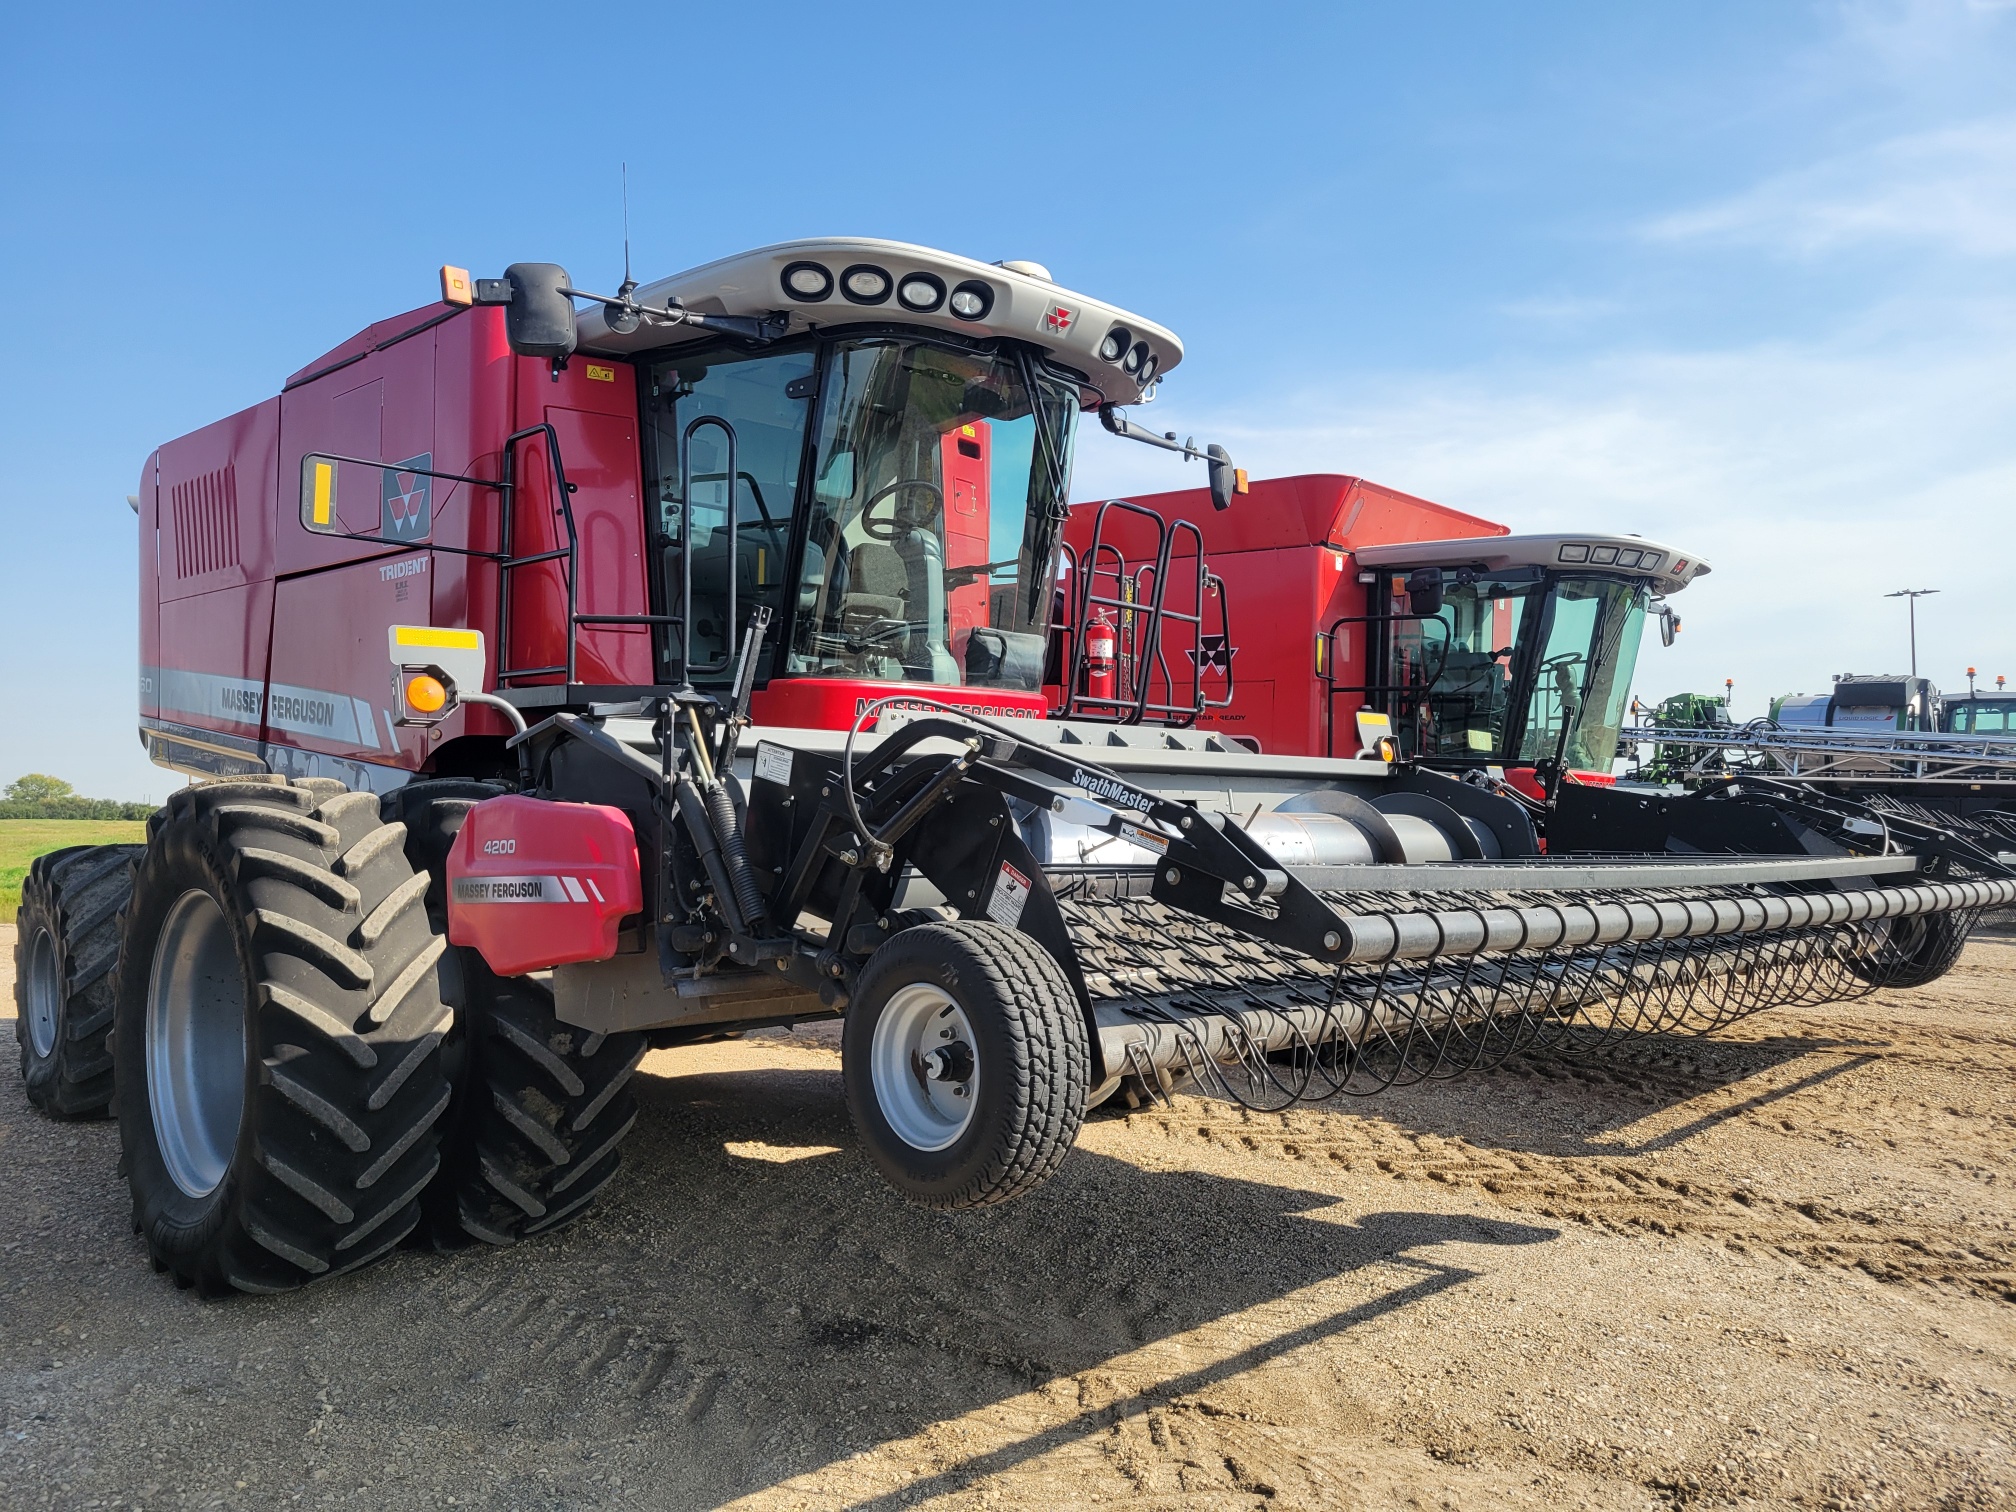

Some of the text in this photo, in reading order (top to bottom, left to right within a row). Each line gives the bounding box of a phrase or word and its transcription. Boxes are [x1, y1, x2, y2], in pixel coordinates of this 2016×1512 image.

[379, 556, 429, 581] TRIDENT
[221, 687, 334, 727] MASSEY FERGUSON
[1072, 768, 1155, 814] SwathMaster
[484, 839, 516, 854] 4200
[457, 881, 542, 899] MASSEY FERGUSON
